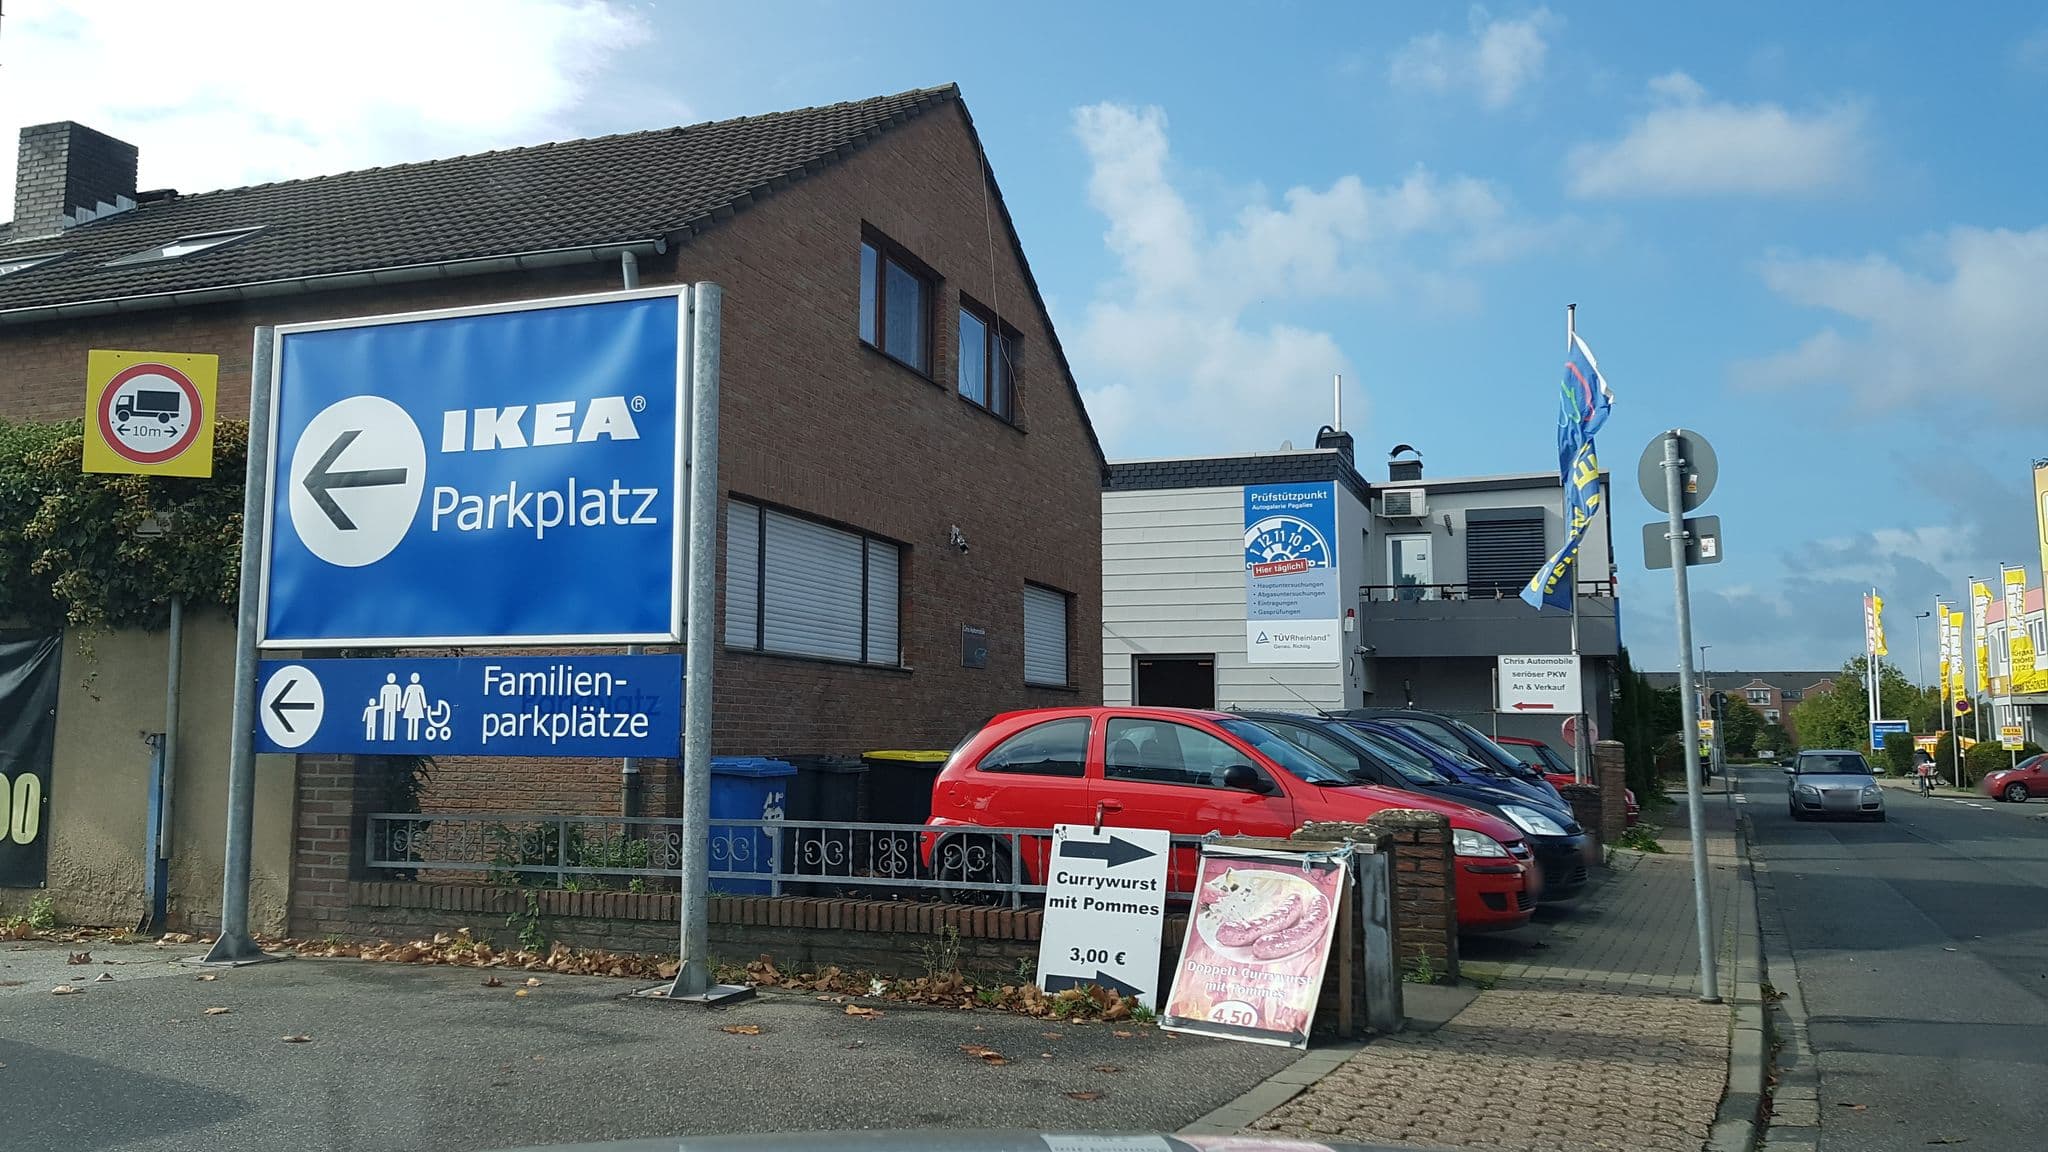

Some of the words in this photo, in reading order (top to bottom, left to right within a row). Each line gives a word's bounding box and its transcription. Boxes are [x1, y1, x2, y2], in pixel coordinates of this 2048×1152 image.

[132, 425, 162, 438] 10m
[1251, 491, 1328, 503] Prüfstützpunkt
[430, 477, 658, 539] Parkplatz
[1251, 503, 1286, 511] Autogalerie
[1255, 565, 1273, 574] Hier
[1274, 561, 1304, 573] täglich!
[1257, 581, 1324, 590] Hauptuntersuchungen
[1257, 590, 1326, 599] Abgasuntersuchungen
[483, 665, 628, 697] Familien-
[1512, 683, 1525, 691] An
[1534, 683, 1566, 691] Verkauf
[482, 704, 650, 746] parkplätze
[1056, 871, 1158, 891] Currywurst
[1048, 895, 1078, 910] mit
[1082, 897, 1160, 916] Pommes
[1069, 947, 1109, 966] 3,00
[1113, 951, 1127, 965] €
[1187, 960, 1238, 980] Doppelt
[1240, 966, 1313, 986] Currywurst
[1205, 980, 1227, 994] mit
[1230, 983, 1287, 999] Pommes
